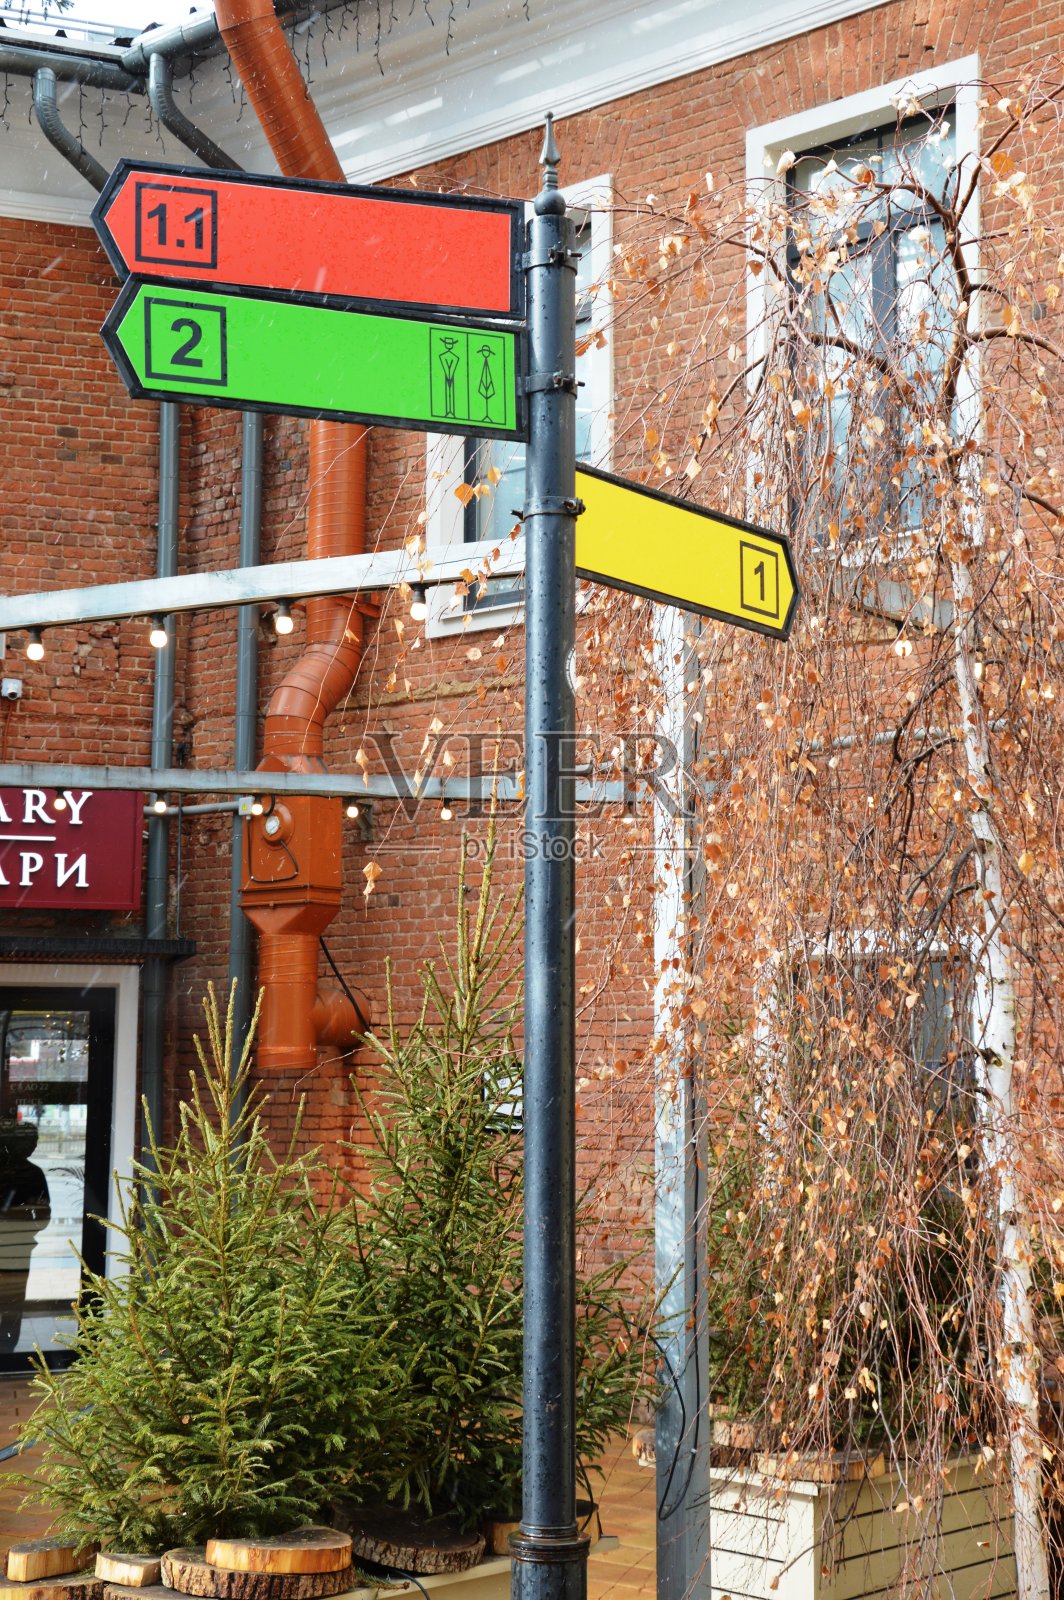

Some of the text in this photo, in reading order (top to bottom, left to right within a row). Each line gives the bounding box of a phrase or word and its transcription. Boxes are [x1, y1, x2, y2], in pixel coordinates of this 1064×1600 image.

[147, 202, 204, 250] 1.1
[170, 317, 203, 368] 2
[754, 560, 765, 602] 1
